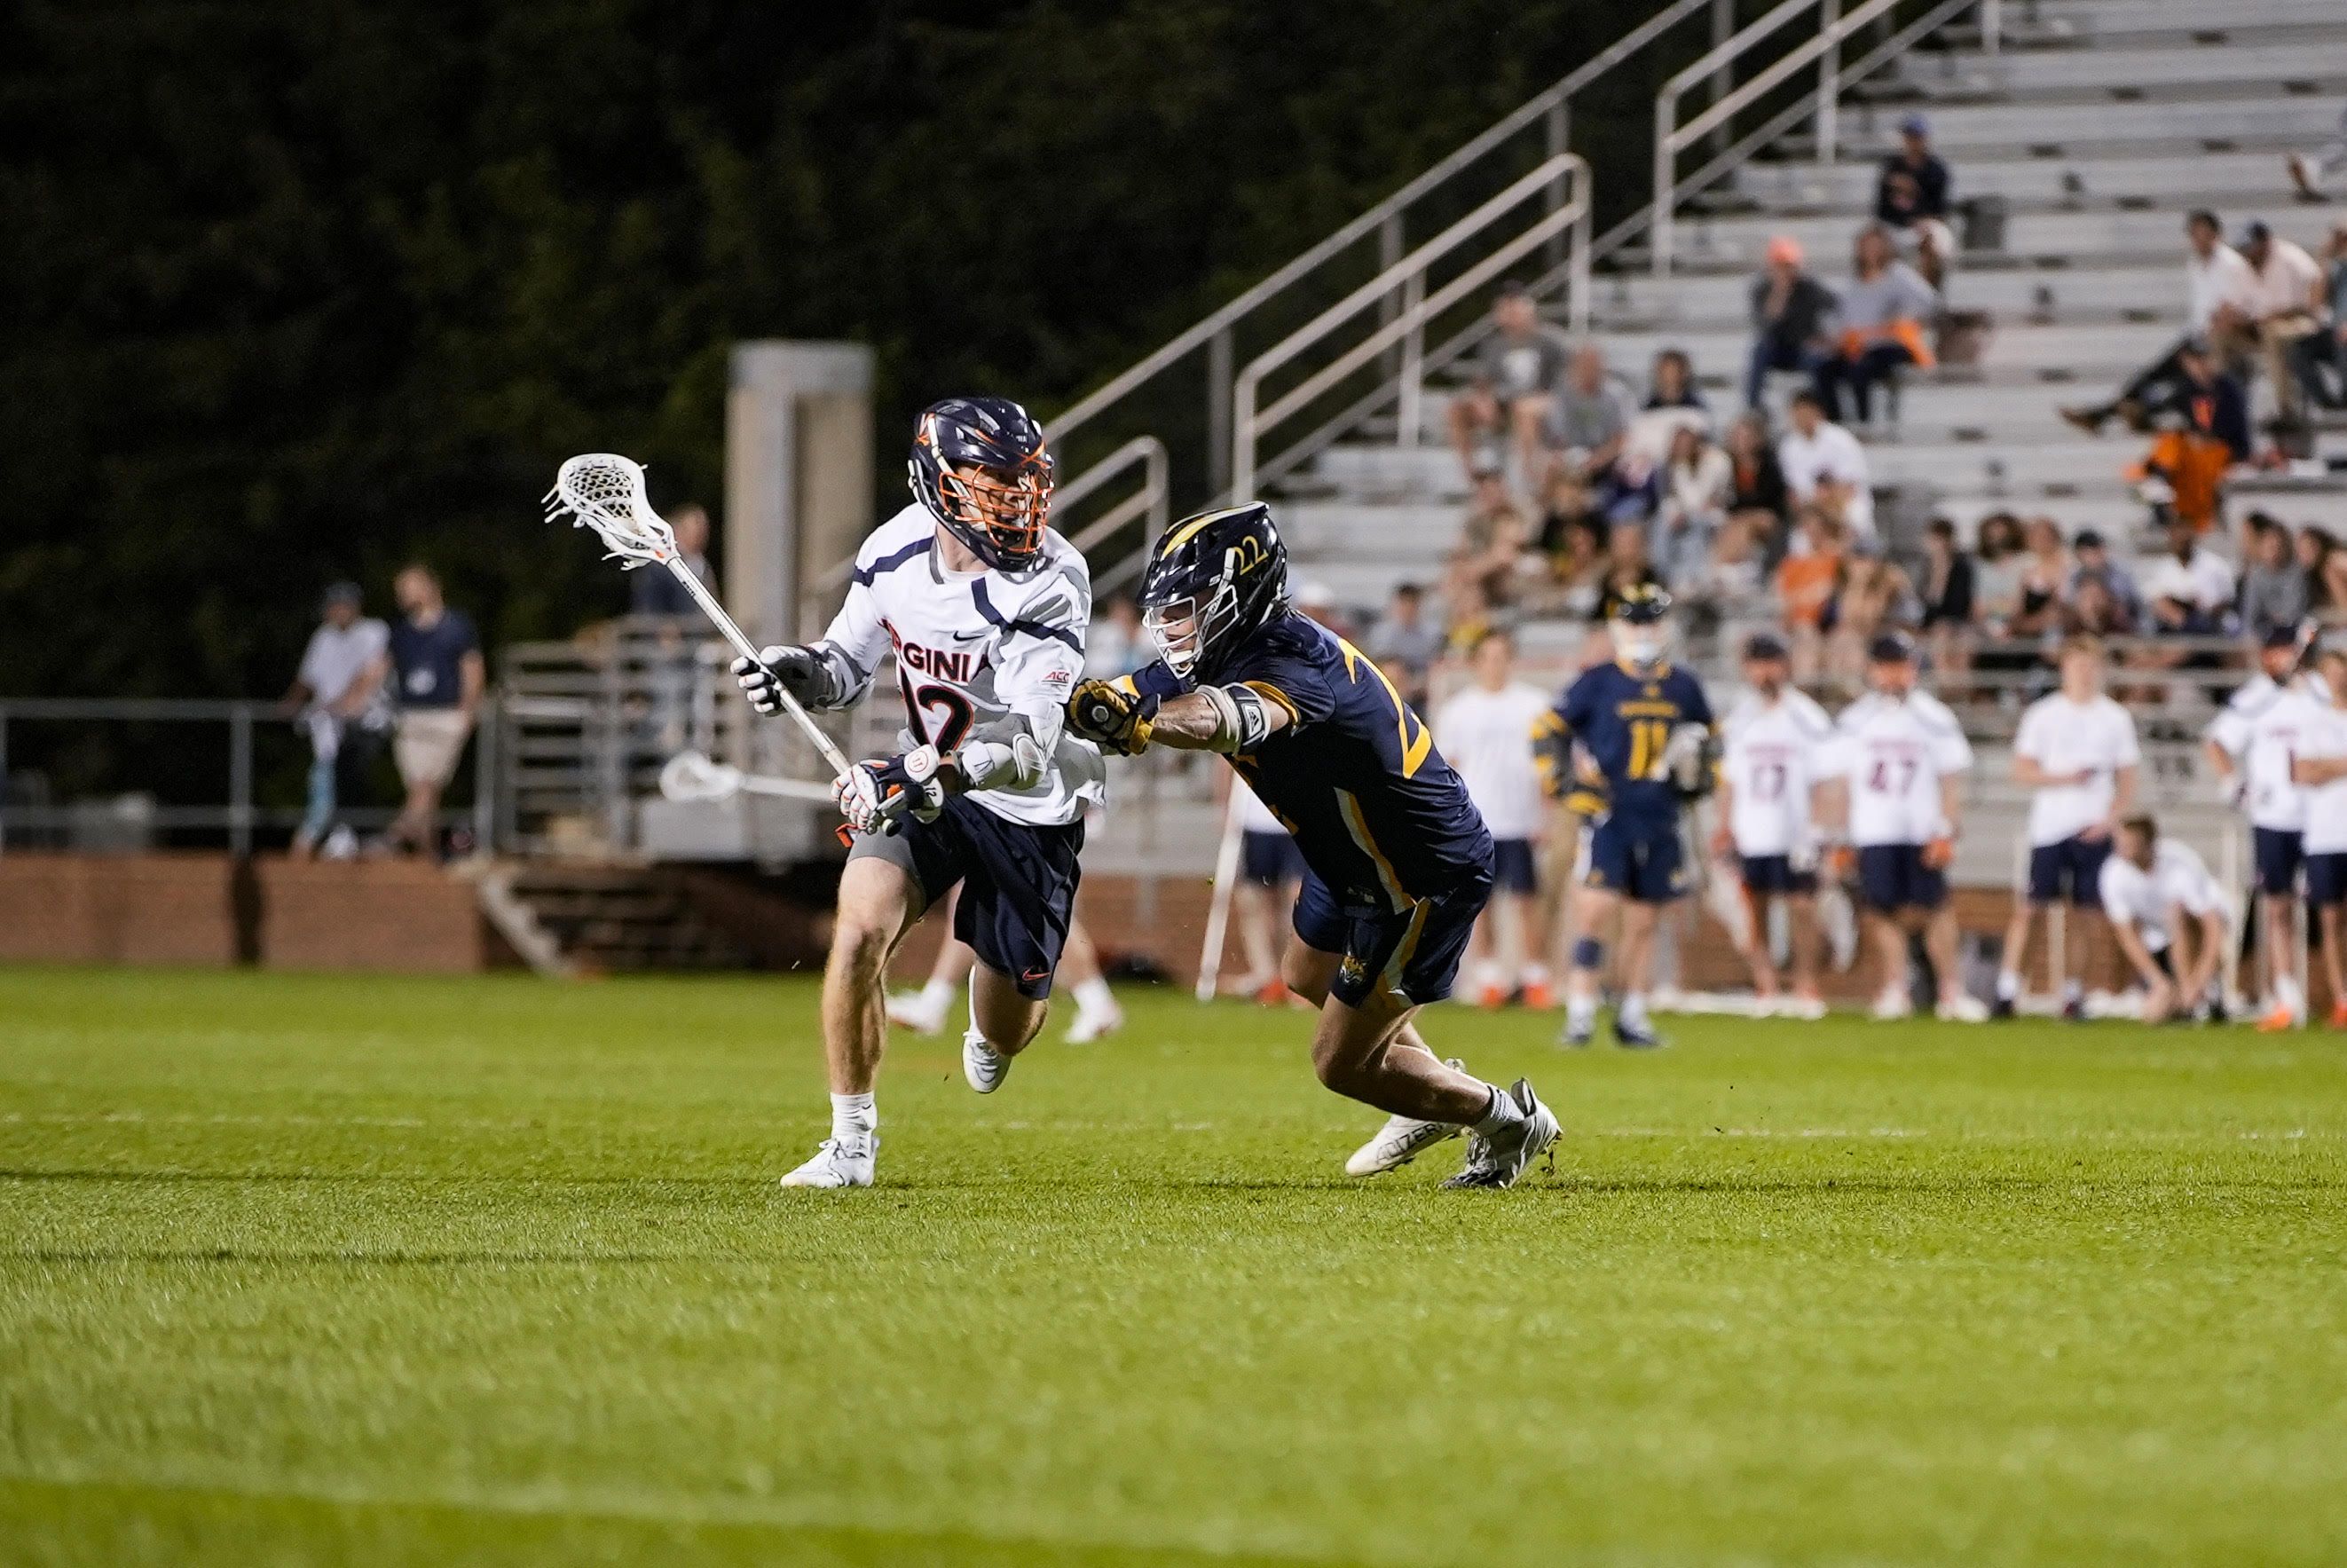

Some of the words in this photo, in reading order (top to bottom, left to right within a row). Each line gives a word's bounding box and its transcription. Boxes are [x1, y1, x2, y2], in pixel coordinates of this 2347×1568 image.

[1233, 535, 1269, 576] 22
[1045, 671, 1070, 682] ACC
[925, 787, 937, 797] 12
[1376, 1123, 1444, 1165] ADIZER
